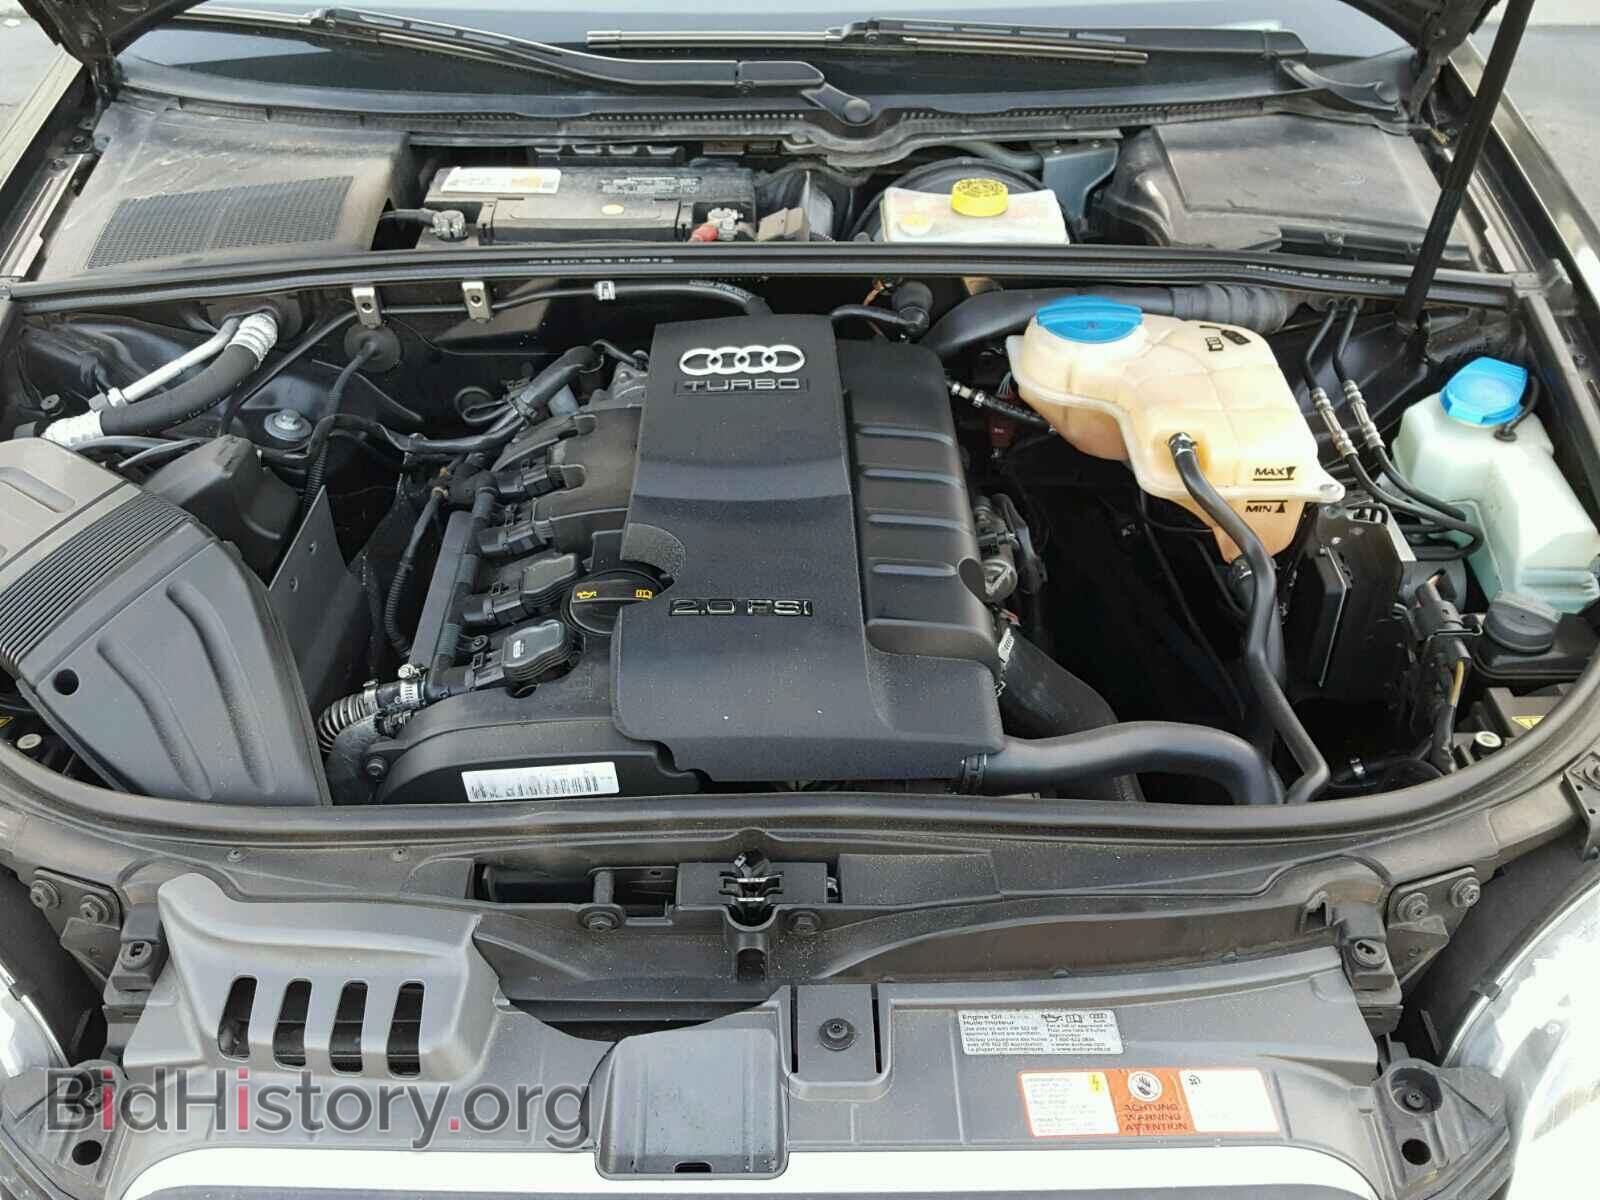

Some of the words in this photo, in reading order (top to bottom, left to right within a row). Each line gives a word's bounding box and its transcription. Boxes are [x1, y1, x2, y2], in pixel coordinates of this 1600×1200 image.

[684, 378, 800, 392] TURBO
[1254, 467, 1285, 476] MAX
[1245, 505, 1272, 513] MIN
[671, 599, 736, 616] 2.0
[1124, 1103, 1179, 1112] ACHTUNG
[1124, 1112, 1181, 1121] WARNING
[1124, 1121, 1188, 1131] ATTENTION
